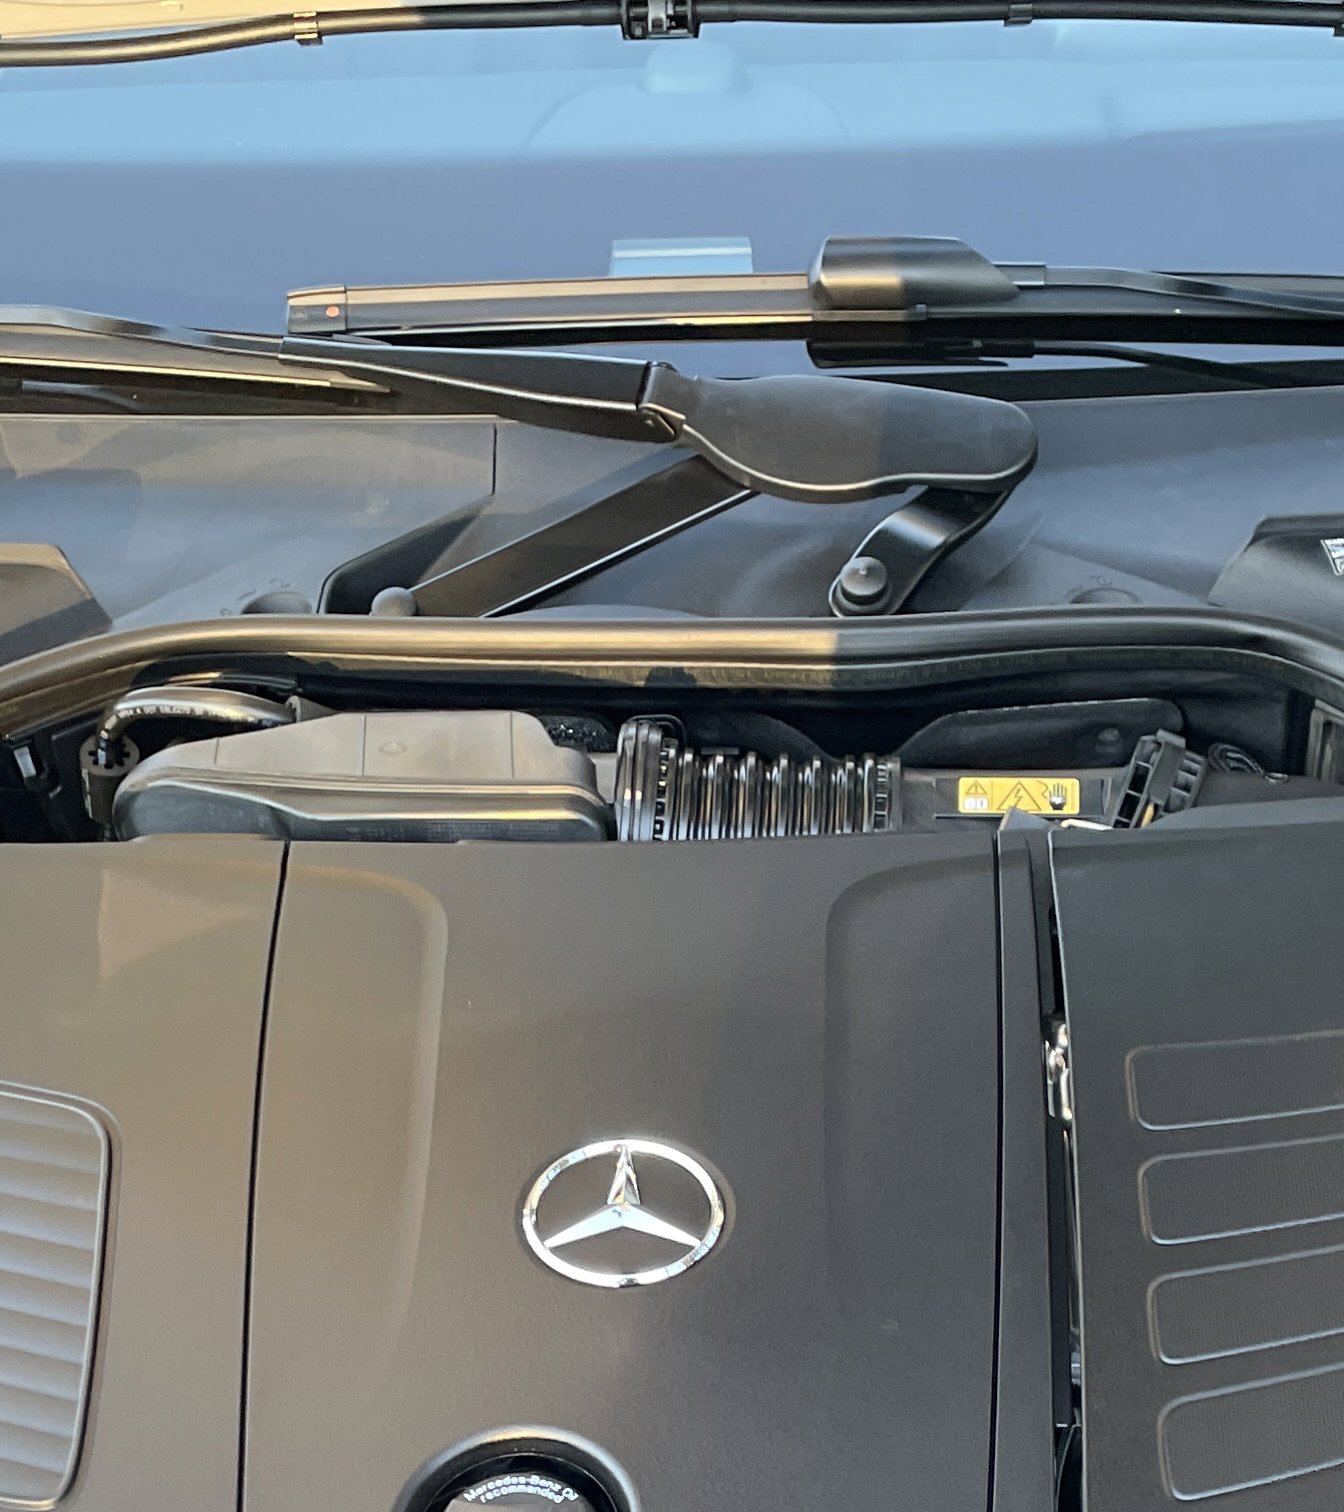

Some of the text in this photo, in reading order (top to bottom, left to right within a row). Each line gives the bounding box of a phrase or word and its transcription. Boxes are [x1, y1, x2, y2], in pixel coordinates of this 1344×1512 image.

[463, 1474, 579, 1502] Mercedes-Benz Oil
[479, 1485, 564, 1504] recommended
